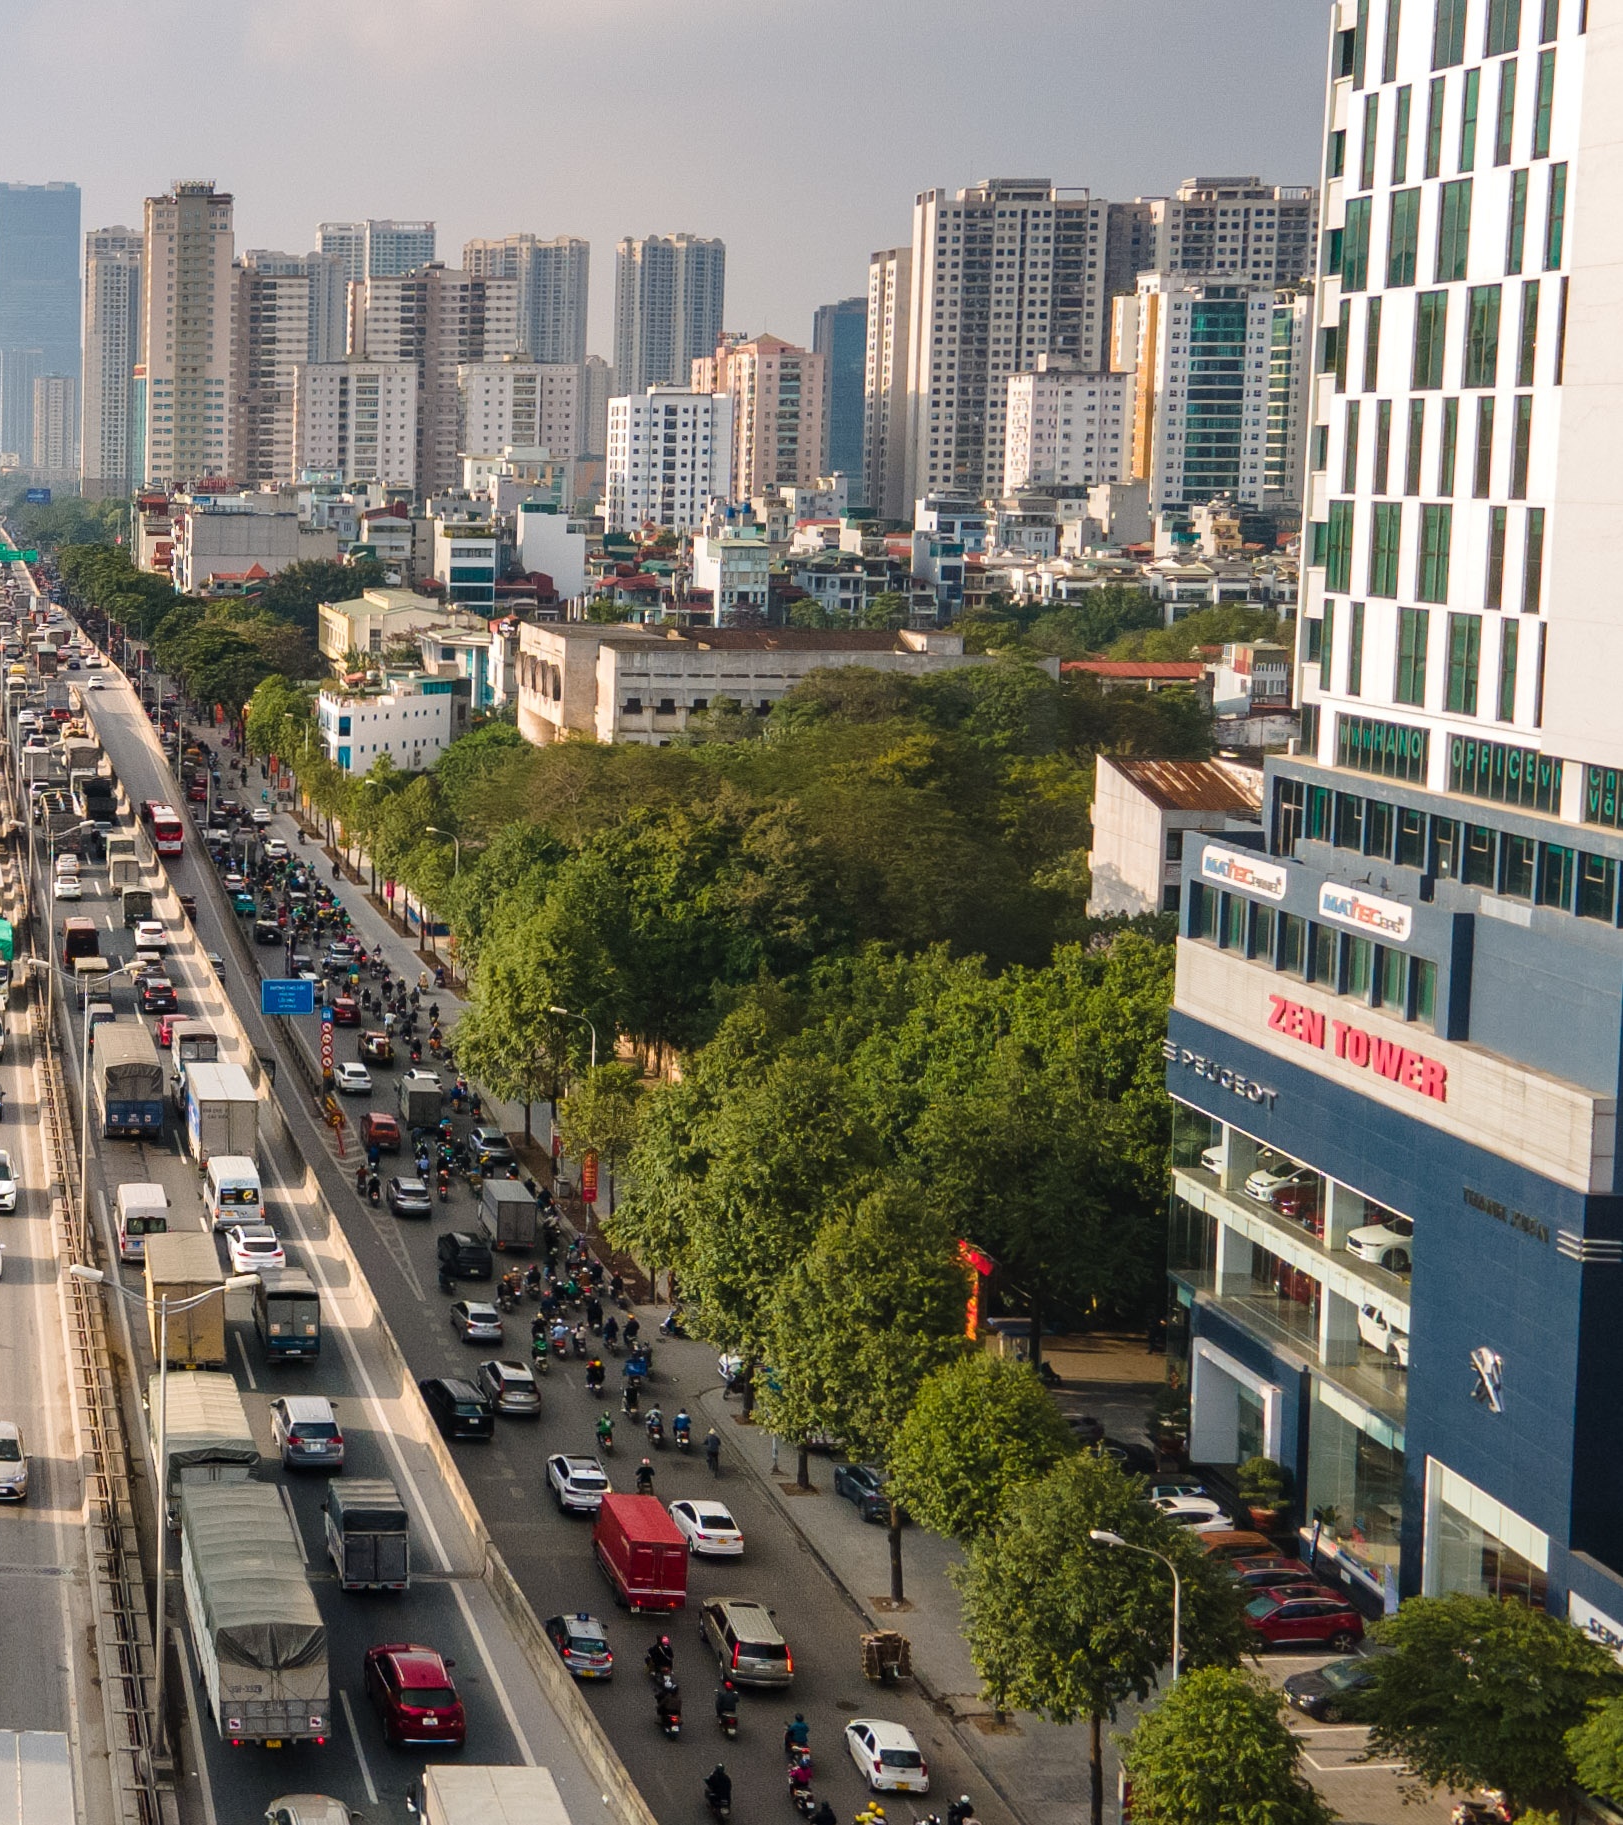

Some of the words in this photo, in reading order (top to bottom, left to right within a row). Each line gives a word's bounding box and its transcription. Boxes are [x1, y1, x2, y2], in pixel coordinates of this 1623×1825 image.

[1181, 1049, 1279, 1111] PEUGEOT
[1267, 994, 1326, 1050] ZEN
[1332, 1019, 1447, 1103] TOWER
